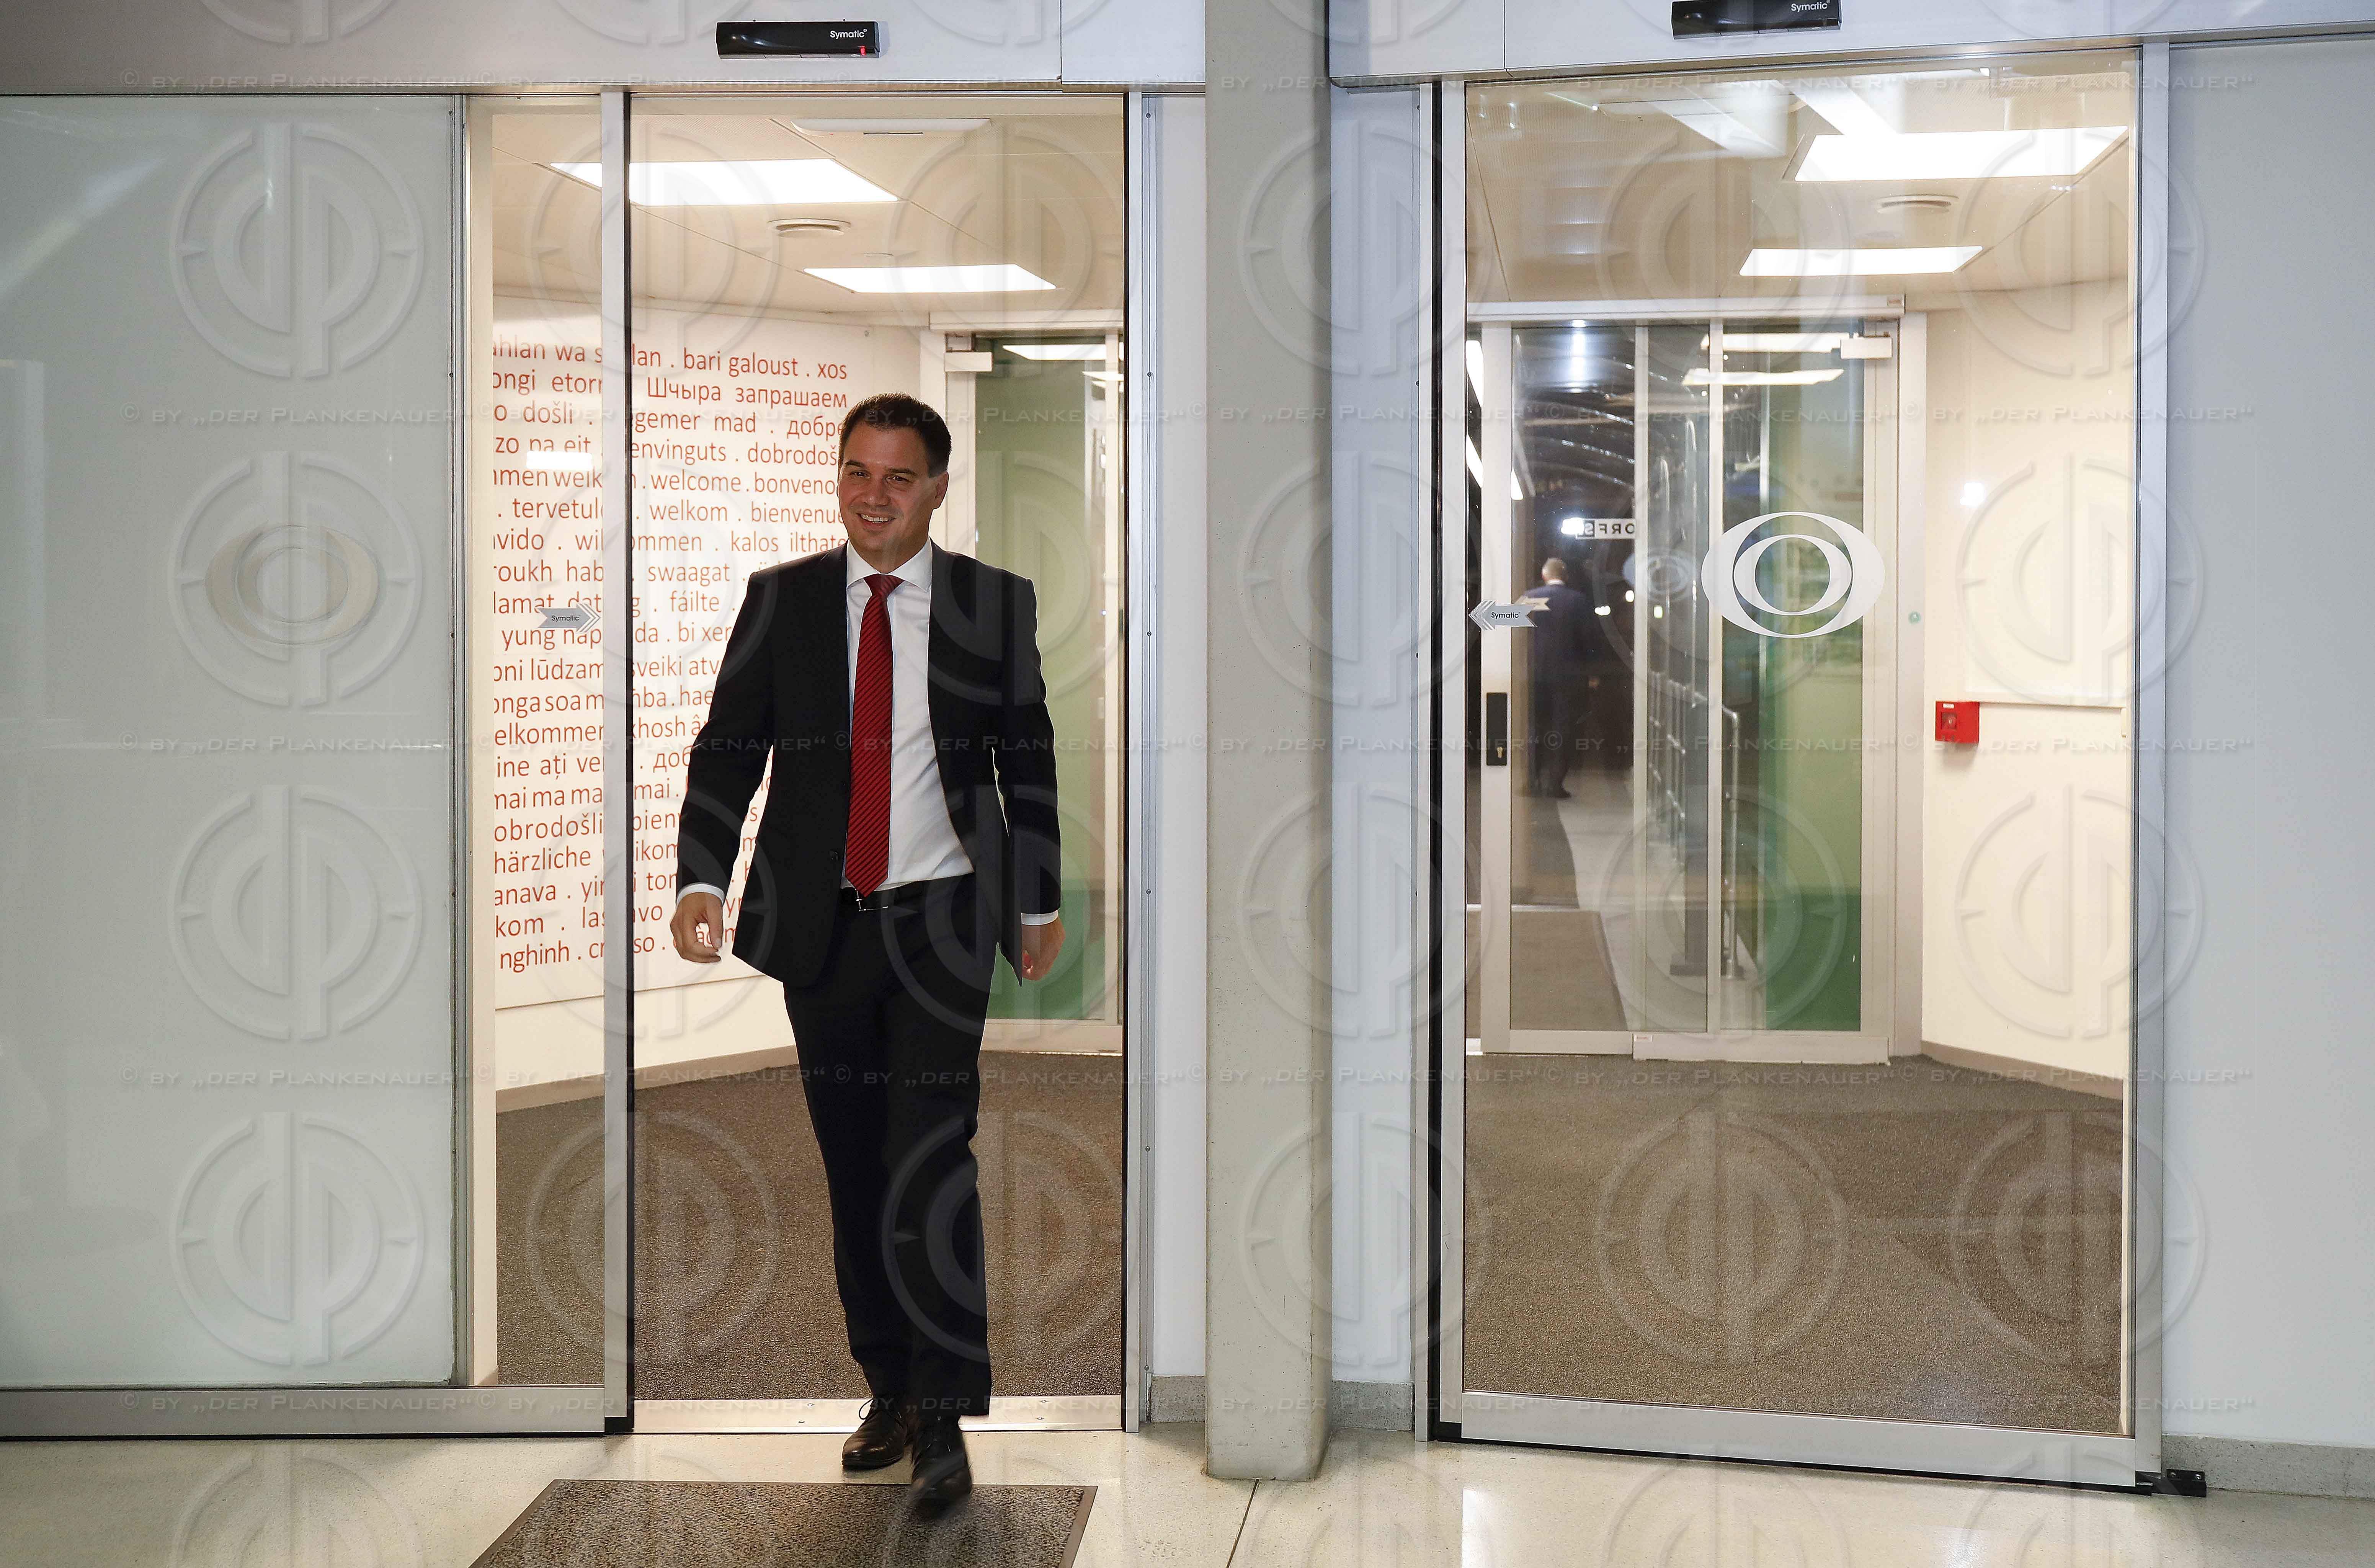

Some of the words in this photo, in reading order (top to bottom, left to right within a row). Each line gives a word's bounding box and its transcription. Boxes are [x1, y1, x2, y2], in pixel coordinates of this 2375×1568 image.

[555, 345, 586, 362] wa
[683, 346, 721, 371] bari
[729, 352, 799, 377] galoust
[817, 363, 848, 380] xos
[647, 376, 721, 405] Шчыра
[735, 387, 848, 410] запрашаем
[522, 400, 573, 425] došli
[632, 412, 701, 433] gemer
[714, 411, 756, 433] mad
[495, 436, 519, 454] zo
[650, 469, 741, 492] welcome
[512, 497, 603, 519] tervetul
[649, 500, 727, 521] welkom
[731, 531, 778, 552] kalos
[493, 559, 552, 582] oukh
[648, 565, 729, 587] swaagat
[670, 590, 719, 612] fáilte
[501, 629, 555, 652] yung
[678, 621, 694, 642] bi
[689, 658, 720, 676] atv
[545, 695, 581, 712] soa
[691, 714, 709, 737] â
[576, 756, 604, 773] ve
[532, 790, 565, 808] ma
[494, 845, 591, 874] härzliche
[500, 940, 569, 973] nghinh
